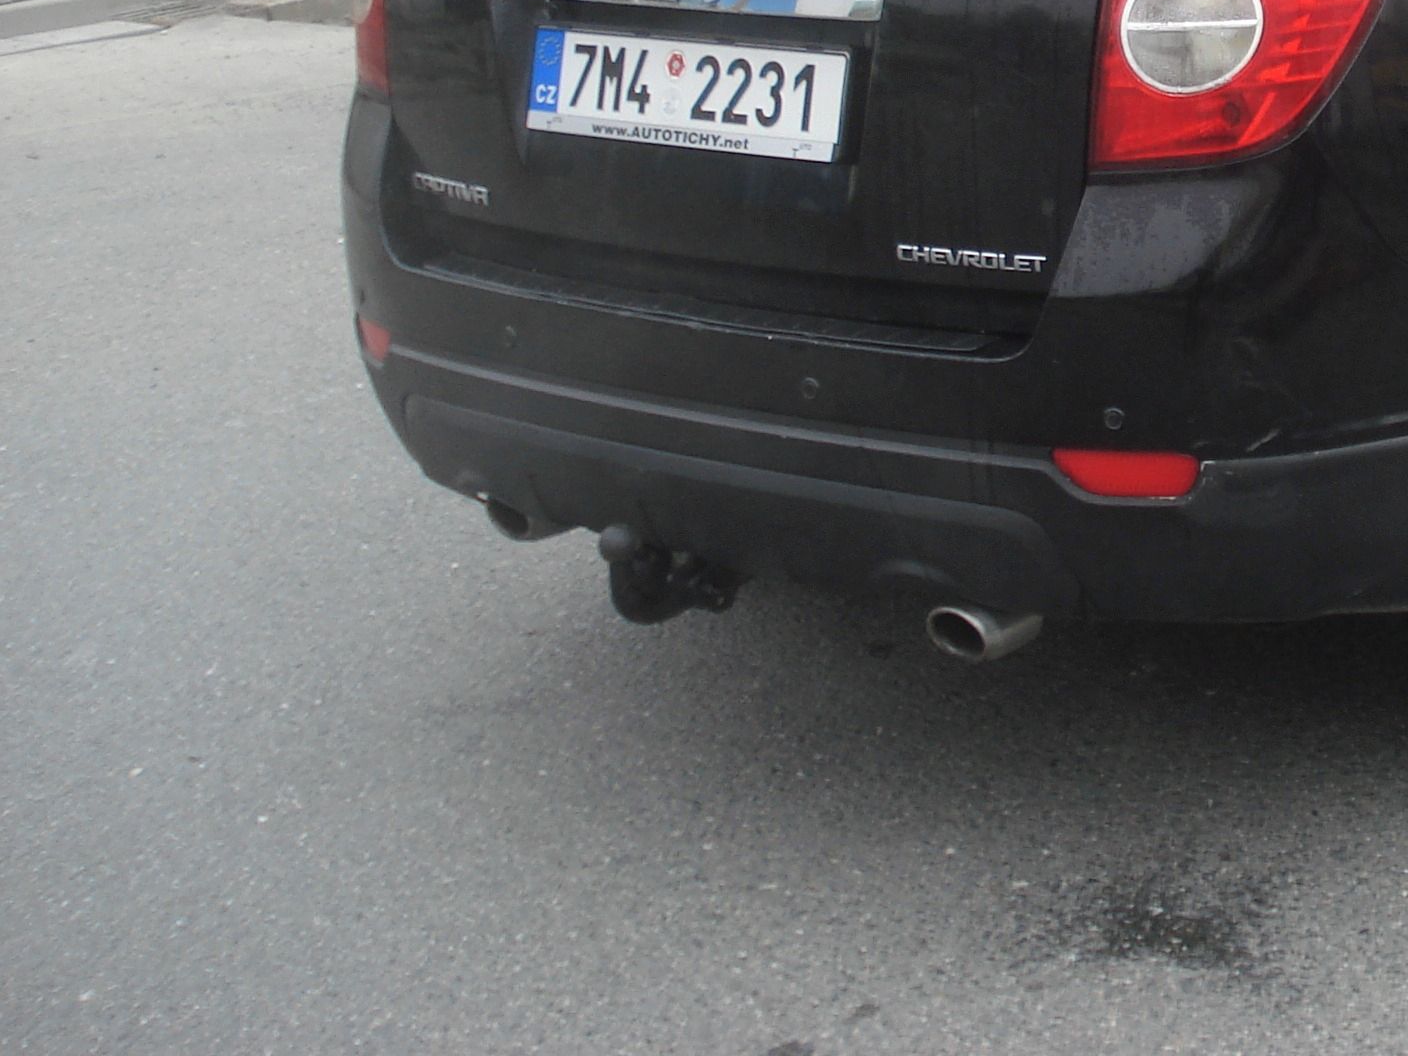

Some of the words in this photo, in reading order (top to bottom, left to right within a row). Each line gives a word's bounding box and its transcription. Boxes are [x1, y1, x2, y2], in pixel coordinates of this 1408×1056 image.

[535, 84, 557, 105] CZ
[569, 43, 651, 114] 7M4
[690, 55, 817, 132] 2231
[592, 122, 750, 151] www.AUTOTICHY.net
[896, 243, 1047, 273] CHEVROLET
